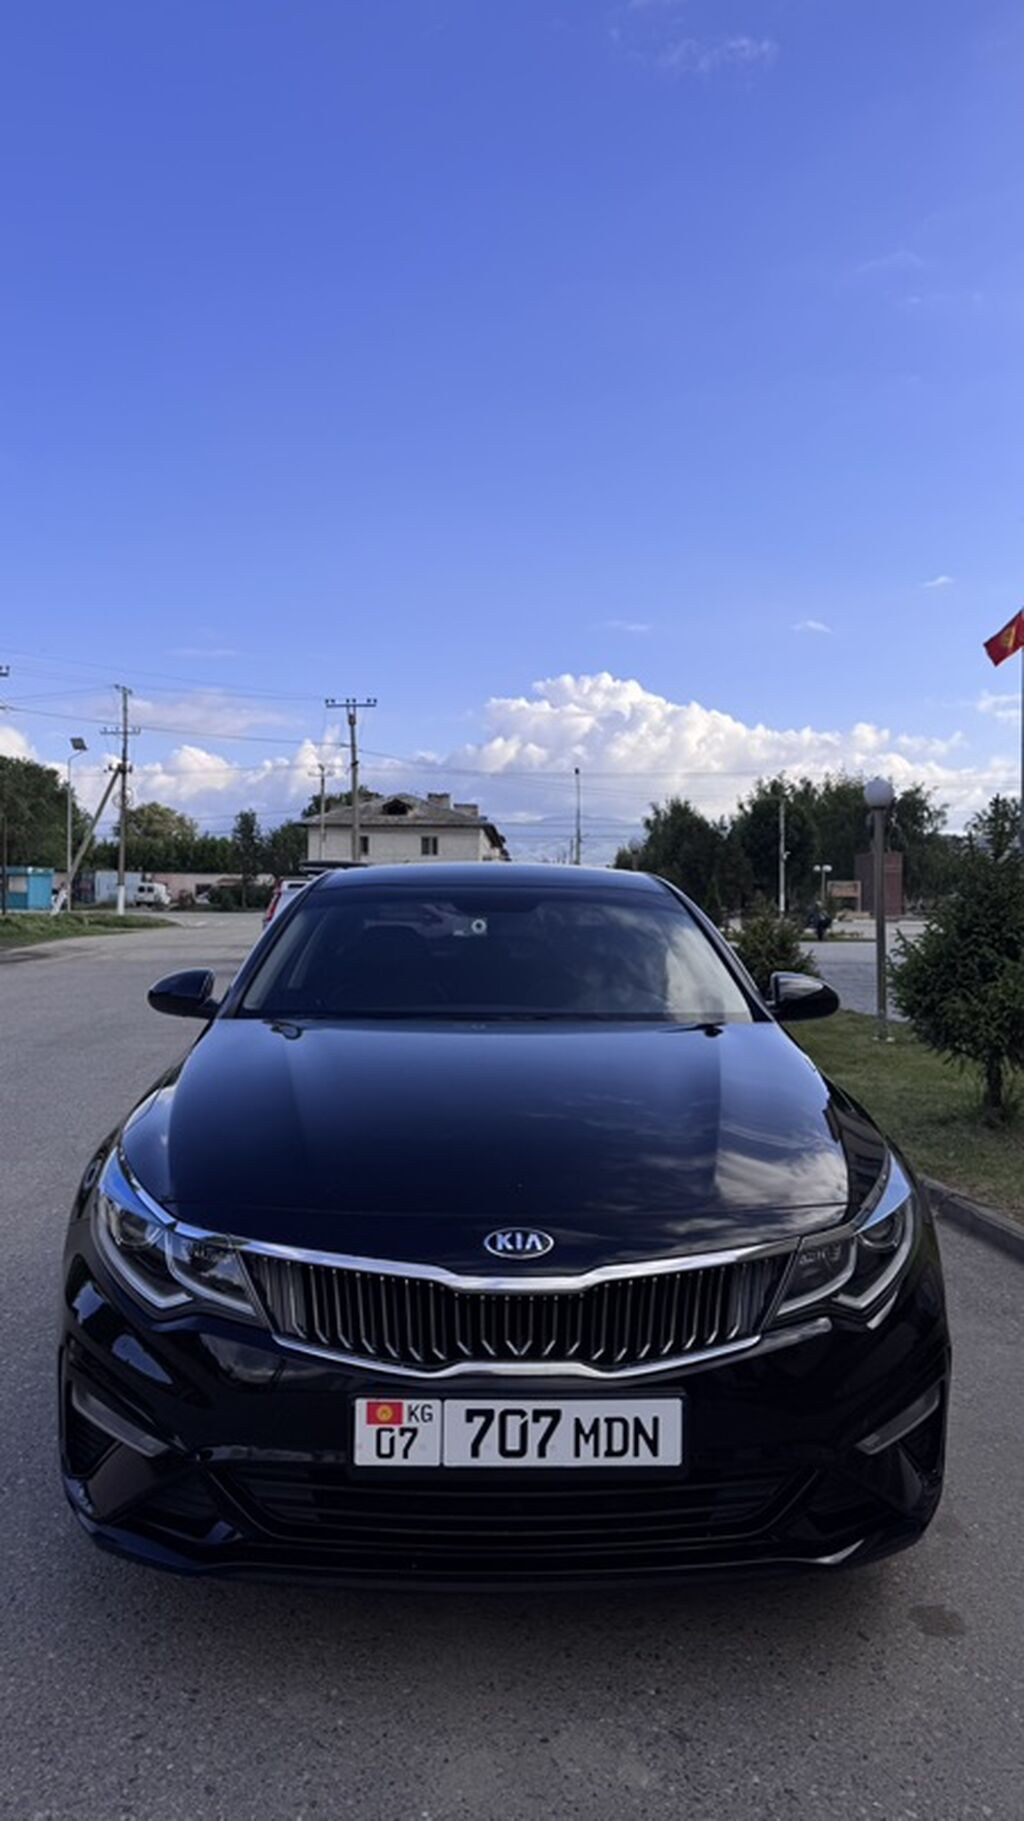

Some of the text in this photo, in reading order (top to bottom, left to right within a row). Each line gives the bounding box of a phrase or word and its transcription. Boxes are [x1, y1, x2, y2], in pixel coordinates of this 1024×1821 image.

[496, 1232, 543, 1251] KIA
[407, 1404, 434, 1424] KG
[375, 1427, 418, 1459] 07
[465, 1408, 659, 1458] 707 MDN
